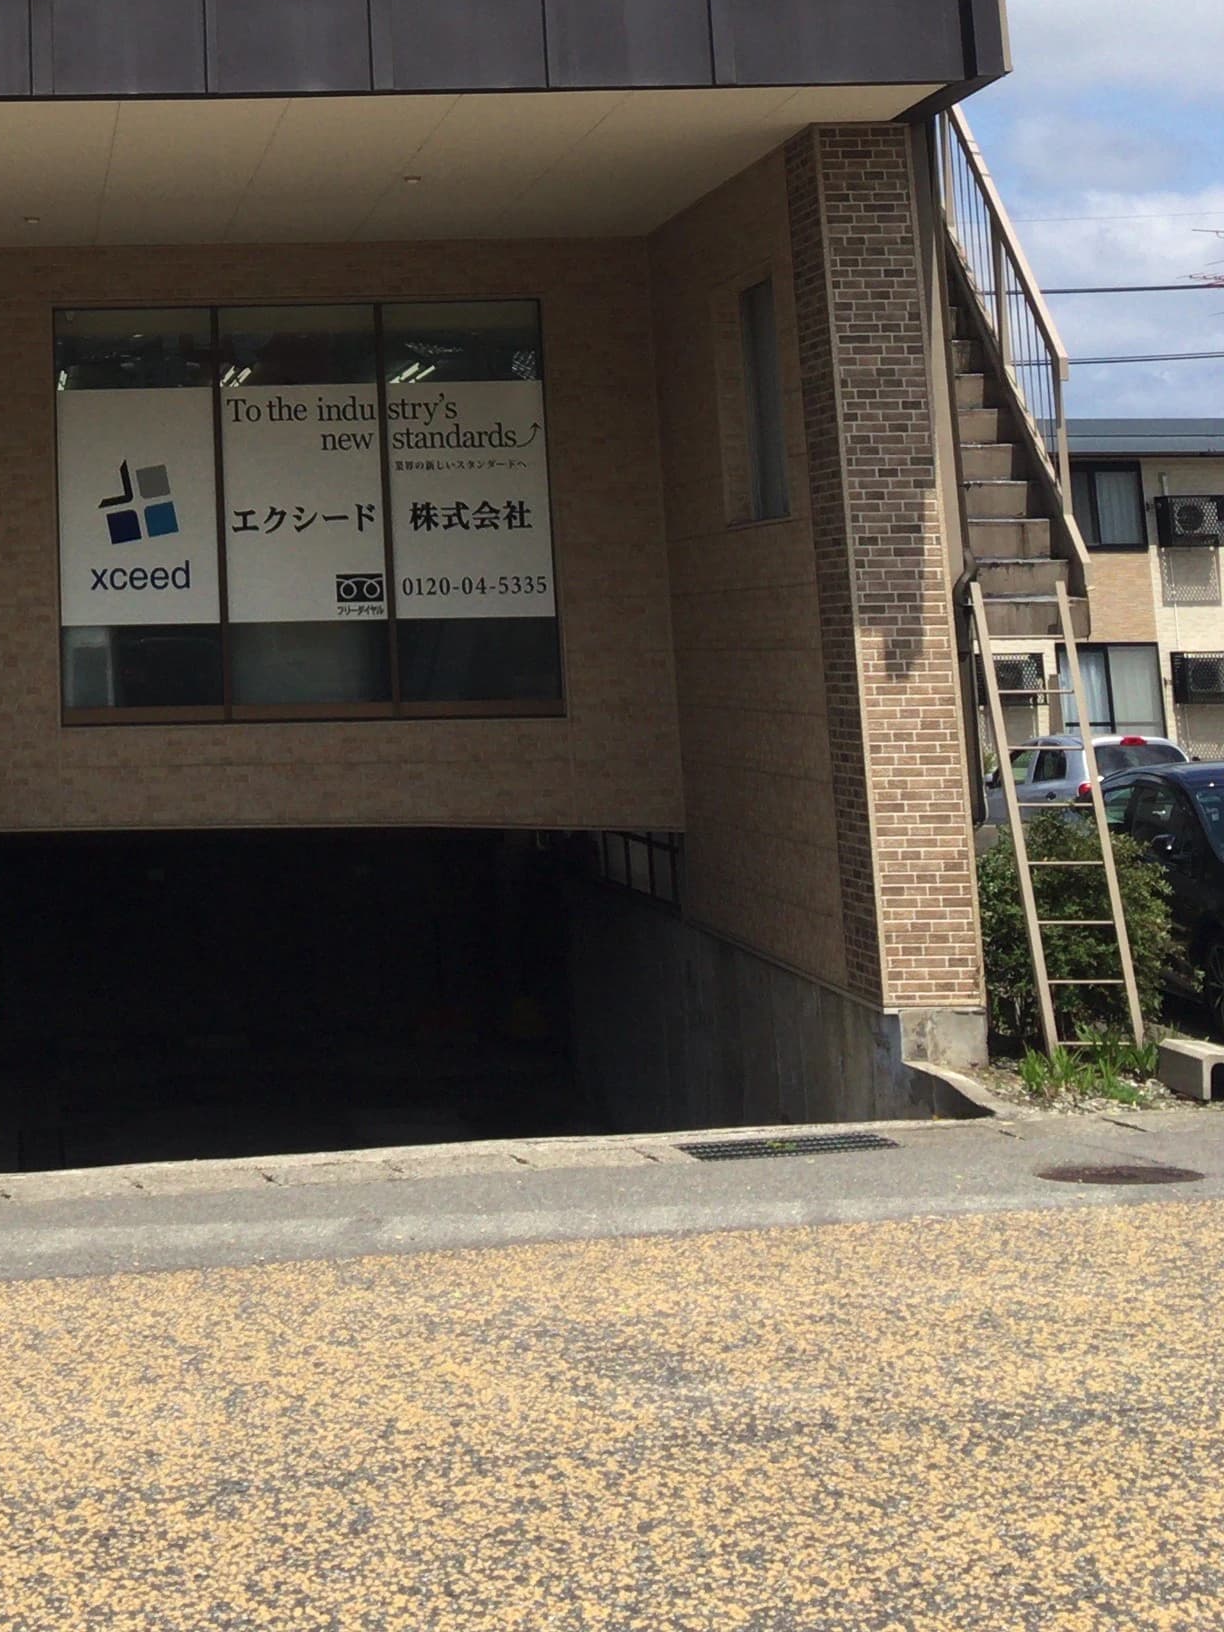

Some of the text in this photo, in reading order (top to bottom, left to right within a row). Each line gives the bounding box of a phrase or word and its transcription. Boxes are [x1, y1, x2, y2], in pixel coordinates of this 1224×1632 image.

[227, 398, 262, 423] To
[267, 396, 307, 422] the
[321, 423, 517, 451] new standards
[231, 499, 534, 534] エクシード 株式会社
[90, 559, 191, 591] xceed
[401, 575, 548, 597] 0120-04-5335
[337, 604, 385, 616] フリーダイヤル
